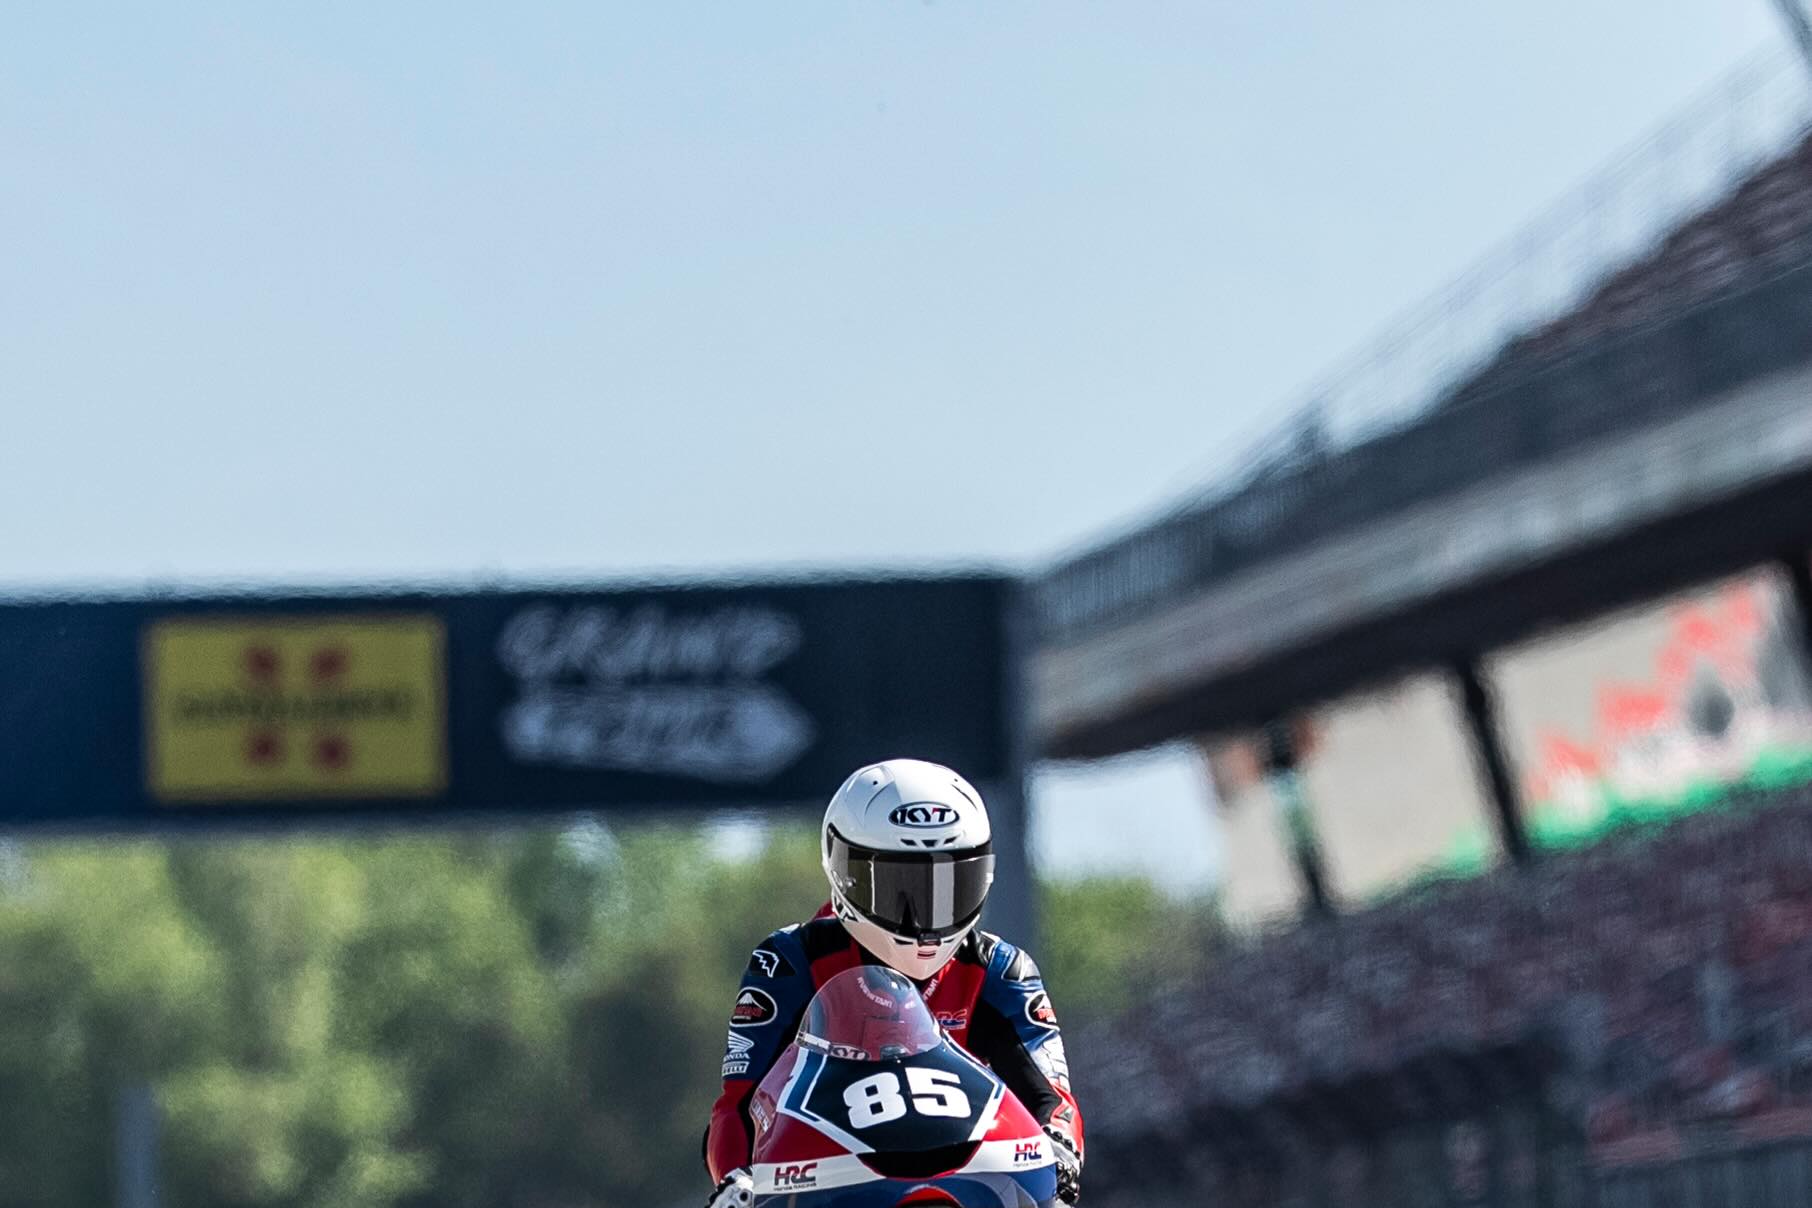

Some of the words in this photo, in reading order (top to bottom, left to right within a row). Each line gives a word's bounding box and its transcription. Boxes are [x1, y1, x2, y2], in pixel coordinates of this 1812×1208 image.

[899, 808, 952, 823] KYT
[843, 1067, 971, 1129] 85
[1014, 1142, 1042, 1162] HRC
[774, 1162, 818, 1186] HRC
